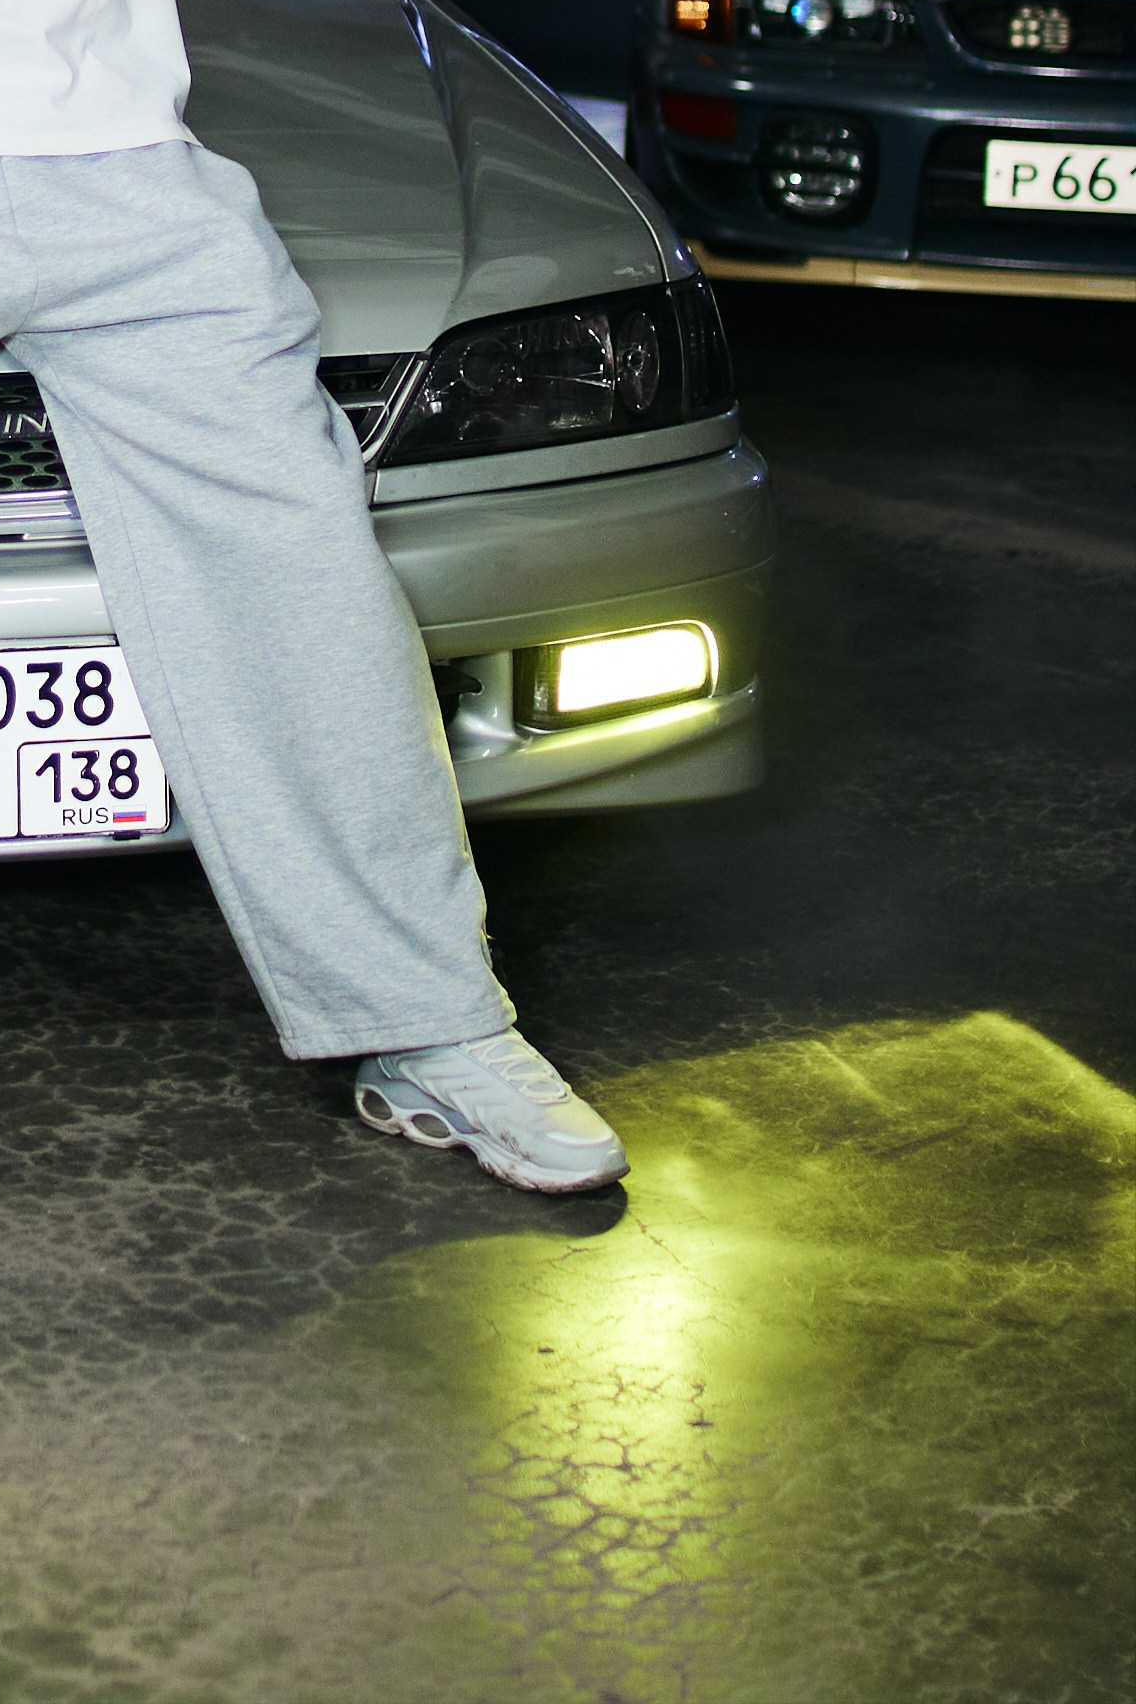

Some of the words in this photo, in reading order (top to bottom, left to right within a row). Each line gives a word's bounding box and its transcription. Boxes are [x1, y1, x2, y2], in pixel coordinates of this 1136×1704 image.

[1011, 163, 1038, 197] P
[1051, 154, 1136, 203] 66
[34, 747, 140, 804] 138
[60, 805, 110, 827] RUS
